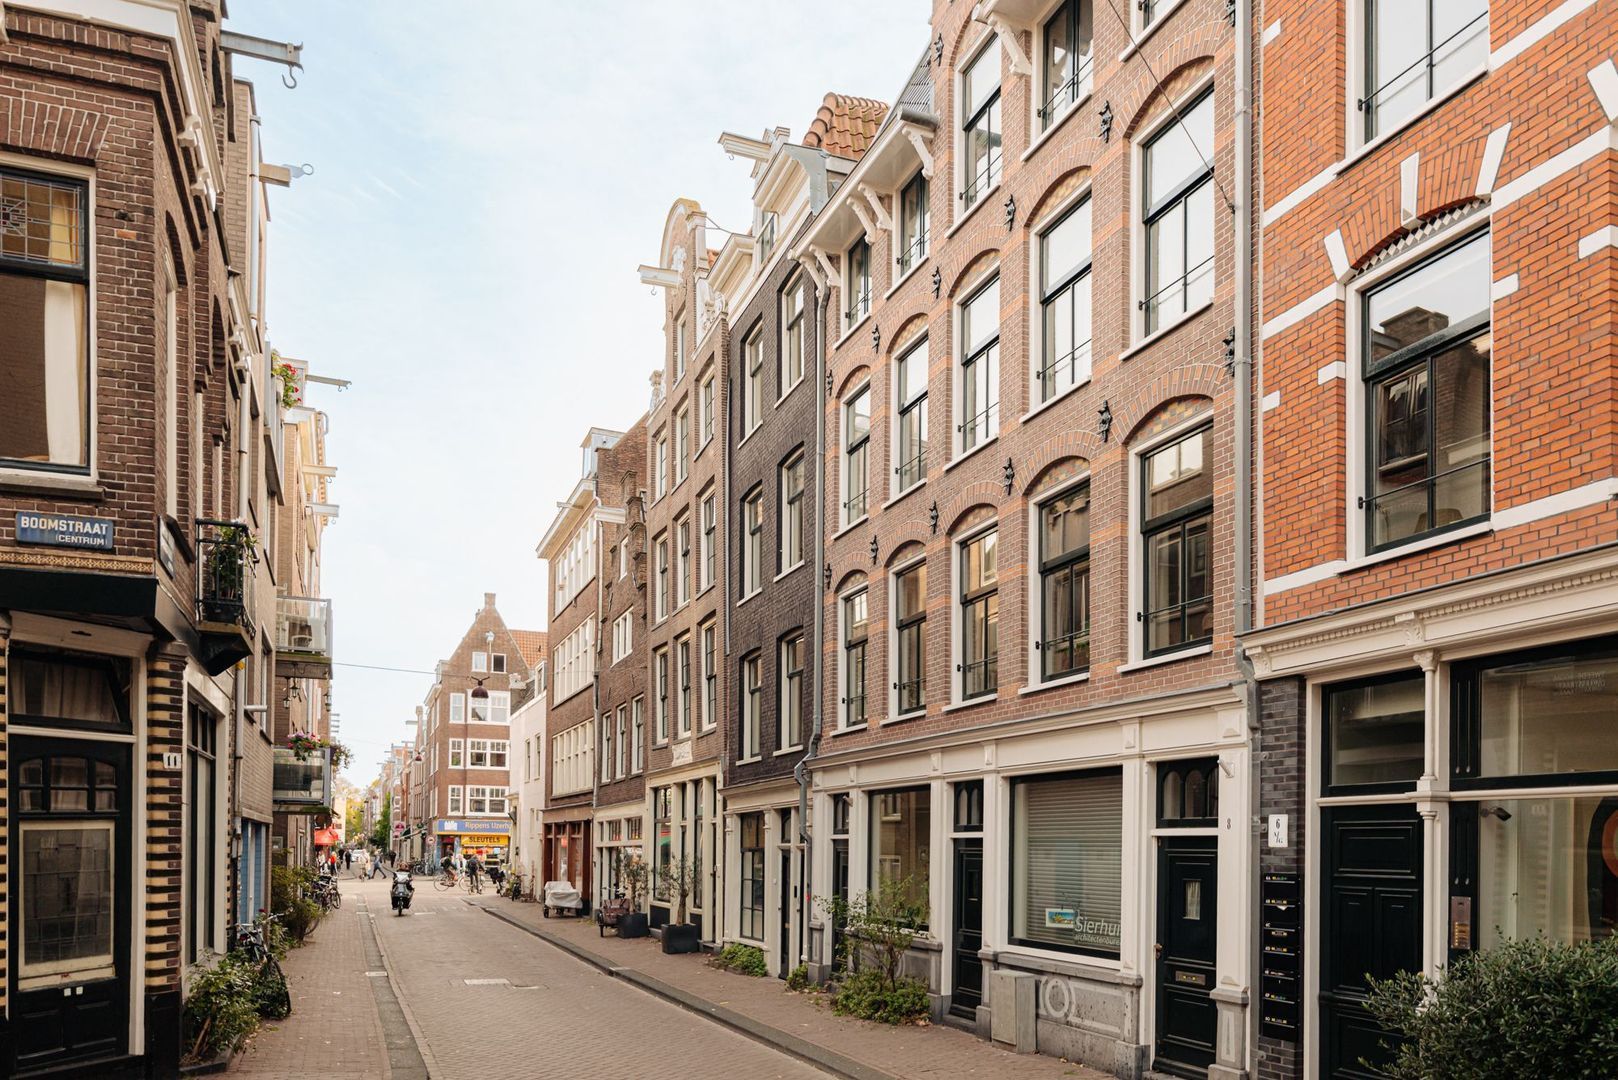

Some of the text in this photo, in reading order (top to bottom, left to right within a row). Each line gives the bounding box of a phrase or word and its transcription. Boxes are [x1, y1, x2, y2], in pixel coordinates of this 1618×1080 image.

[20, 516, 109, 535] BOOMSTRAAT
[55, 534, 108, 546] (CENTRUM)
[167, 754, 177, 767] 11
[465, 821, 489, 830] Rippens
[1226, 818, 1232, 830] 8
[1275, 818, 1281, 829] 6
